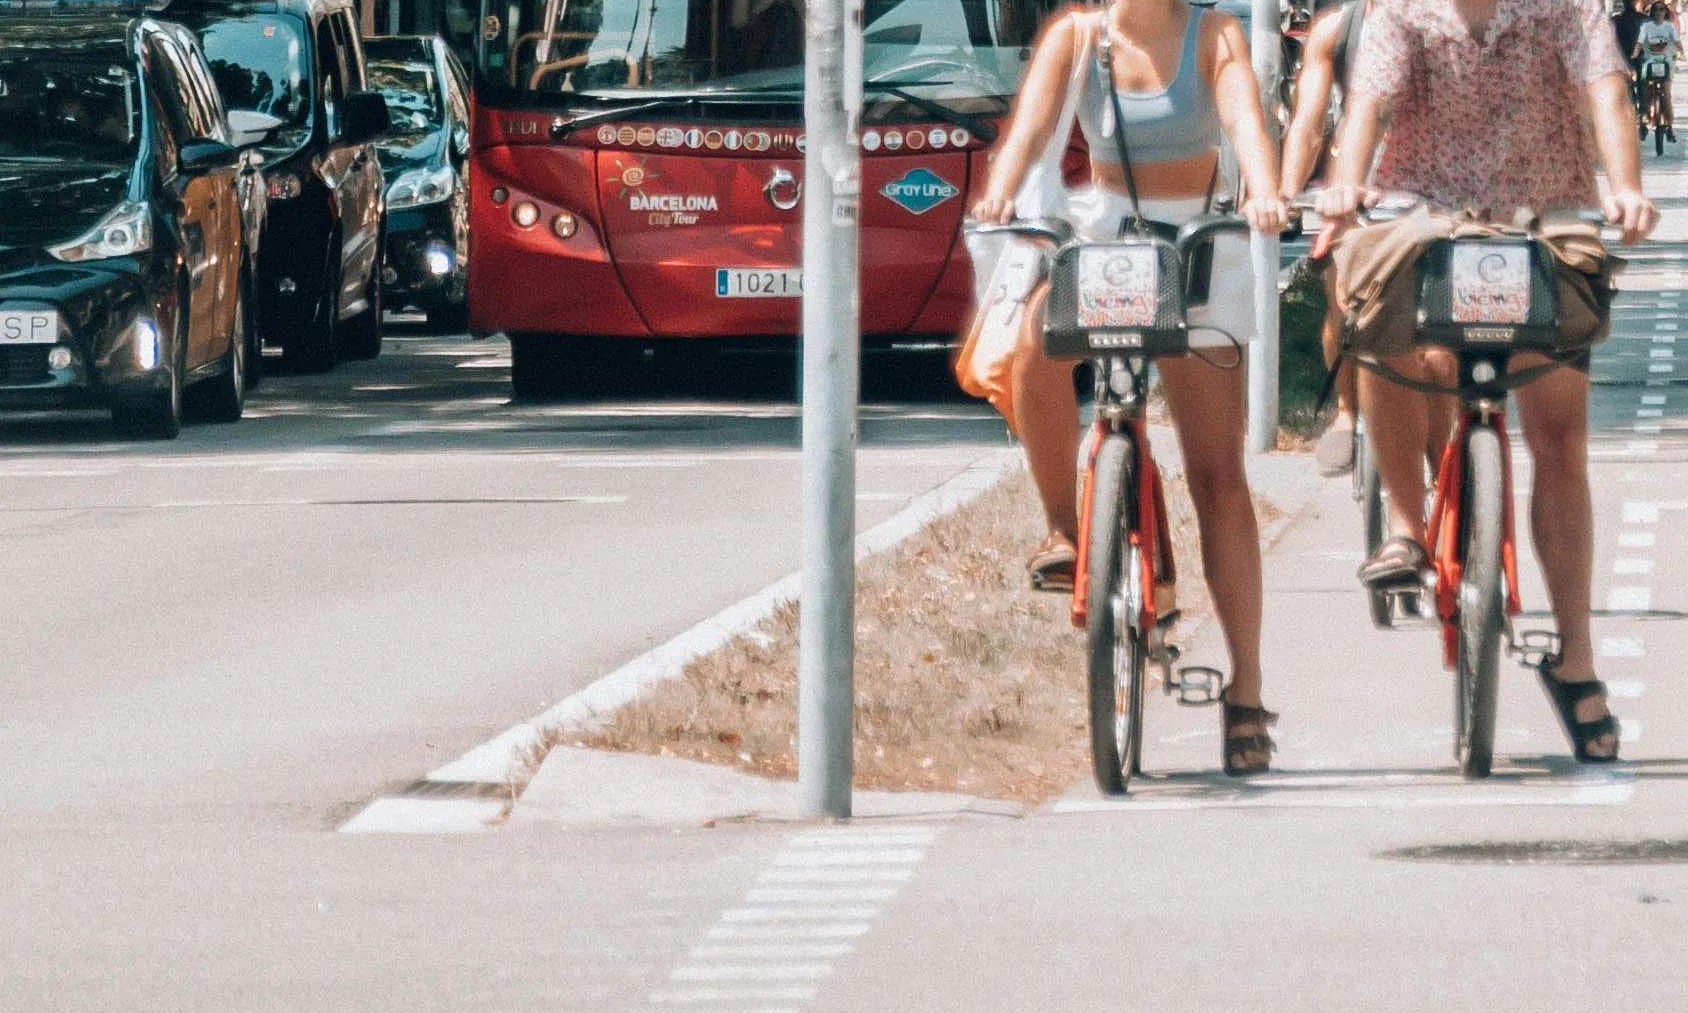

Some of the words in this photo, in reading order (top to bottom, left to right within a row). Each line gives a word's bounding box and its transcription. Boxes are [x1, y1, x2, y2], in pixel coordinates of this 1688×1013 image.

[923, 183, 953, 198] Line
[629, 195, 719, 211] BARCELONA
[648, 212, 671, 228] City
[671, 212, 699, 225] Tour
[735, 272, 788, 294] 1021
[4, 316, 49, 340] SP
